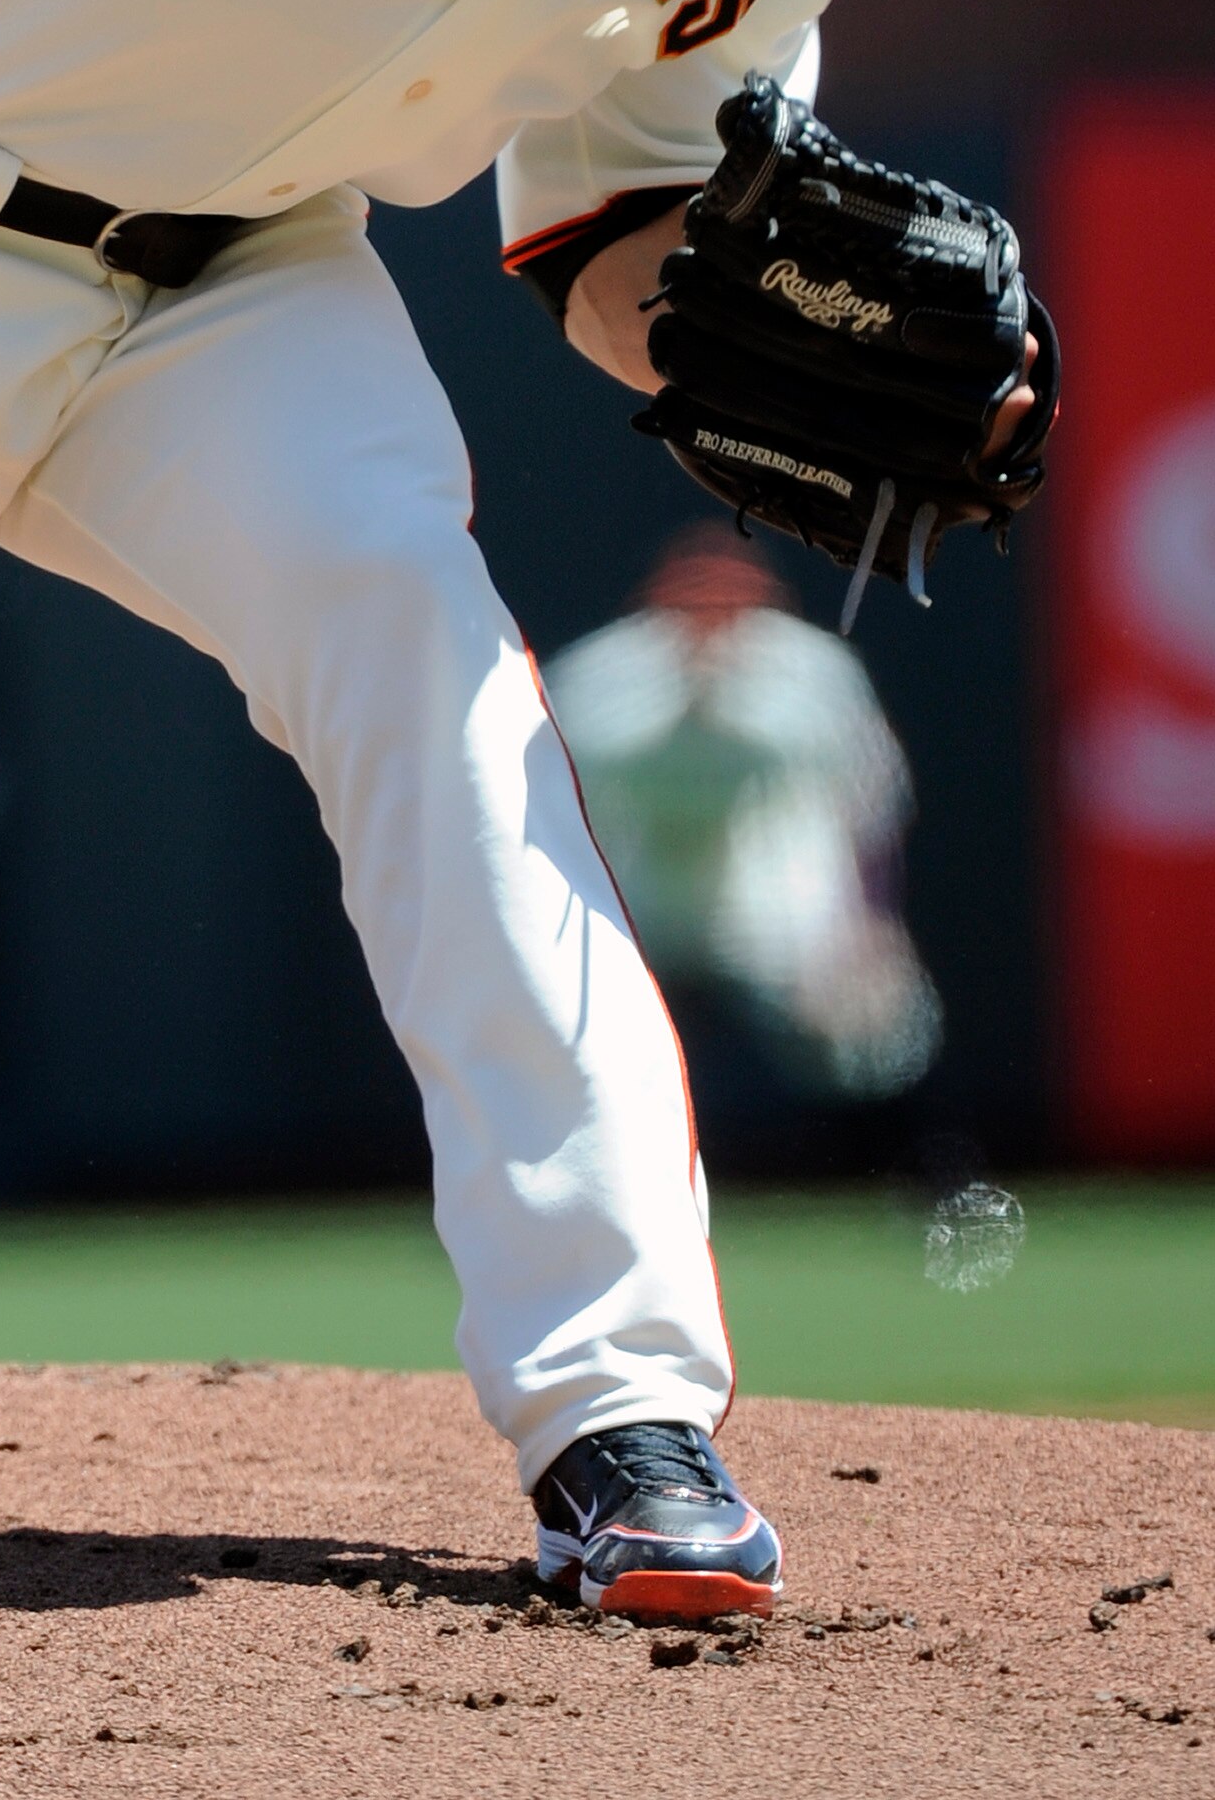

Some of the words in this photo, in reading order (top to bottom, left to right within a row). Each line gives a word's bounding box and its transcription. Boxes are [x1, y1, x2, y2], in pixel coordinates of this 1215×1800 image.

[761, 258, 894, 332] Rawlings
[694, 428, 721, 451] PRO
[718, 436, 797, 476] PREFERRED
[794, 462, 853, 500] LEATHER
